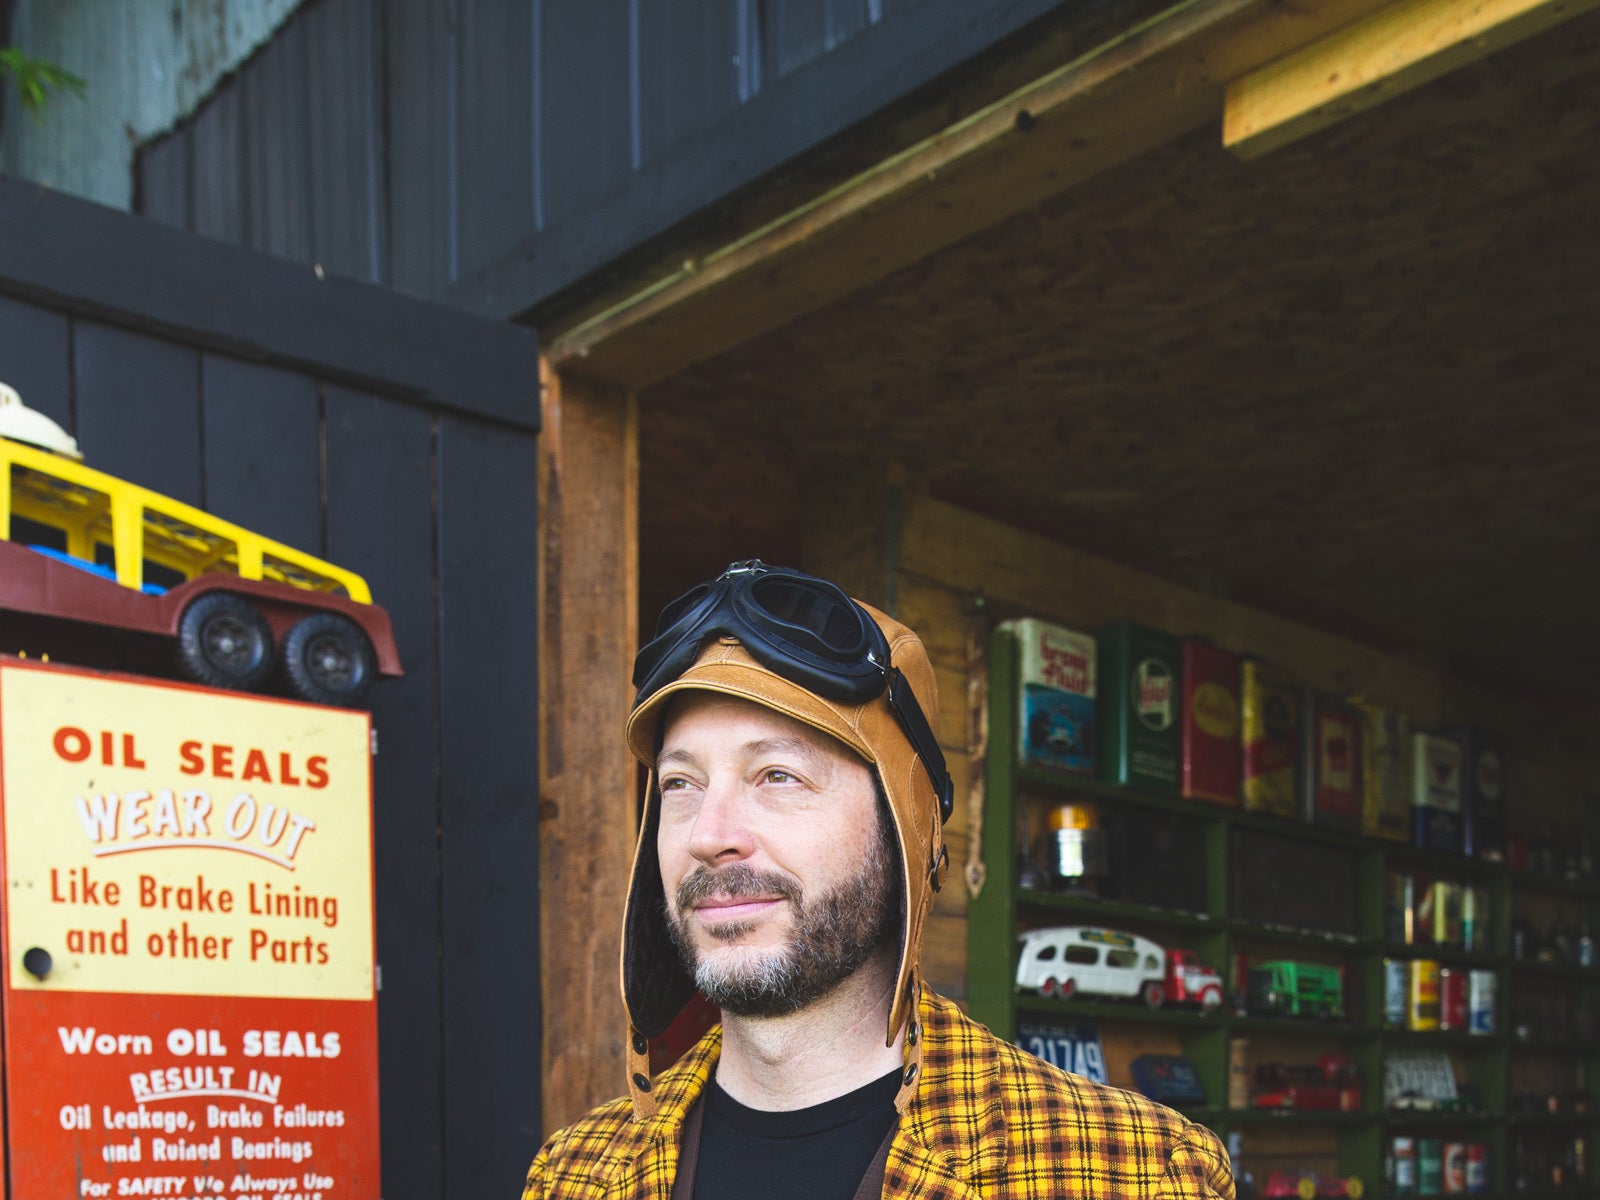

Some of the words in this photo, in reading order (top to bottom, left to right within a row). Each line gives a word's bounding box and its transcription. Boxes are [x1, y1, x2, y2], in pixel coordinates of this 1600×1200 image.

[52, 726, 146, 769] OIL
[179, 740, 330, 789] SEALS
[76, 789, 213, 842] WEAR
[224, 792, 316, 860] OUT
[50, 867, 120, 905] Like
[139, 875, 234, 913] Brake
[249, 883, 338, 928] Lining
[66, 918, 129, 955] and
[147, 922, 233, 960] other
[250, 929, 329, 965] Parts
[58, 1027, 152, 1055] Worn
[167, 1028, 226, 1056] OIL
[243, 1030, 341, 1058] SEALS
[130, 1066, 234, 1098] RESULT
[248, 1069, 281, 1097] IN
[60, 1104, 91, 1130] Oil
[103, 1103, 196, 1133] Leakage,
[207, 1103, 263, 1129] Brake
[274, 1103, 345, 1127] Failures
[102, 1137, 141, 1163] and
[152, 1136, 221, 1161] Ruined
[231, 1136, 312, 1163] Bearings
[80, 1178, 111, 1197] For
[117, 1176, 186, 1196] SAFETY
[230, 1173, 297, 1193] Always
[303, 1173, 334, 1190] Use
